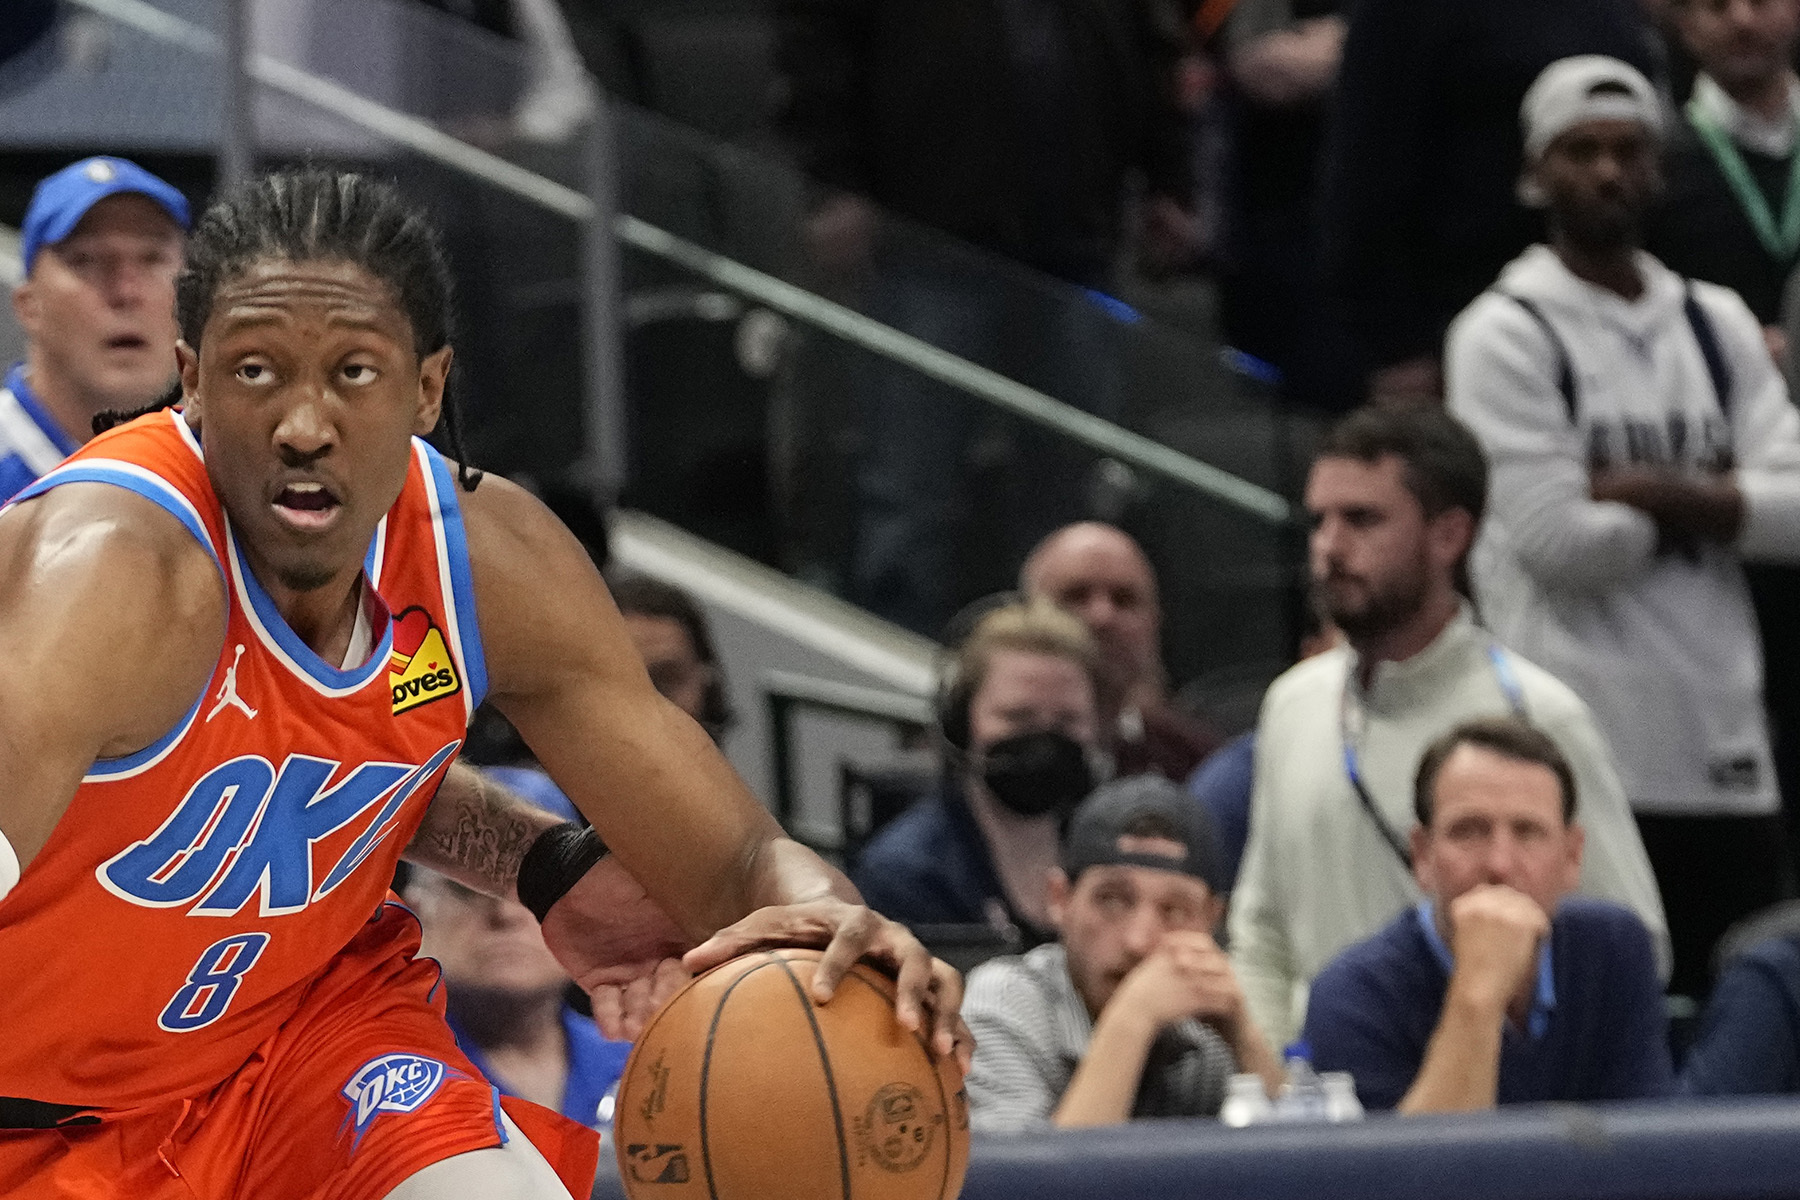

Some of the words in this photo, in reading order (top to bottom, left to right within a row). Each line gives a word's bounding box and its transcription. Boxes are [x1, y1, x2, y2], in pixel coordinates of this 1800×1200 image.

[392, 668, 454, 705] oves
[95, 739, 462, 918] OKC
[157, 931, 271, 1033] 8
[356, 1061, 422, 1127] OKC
